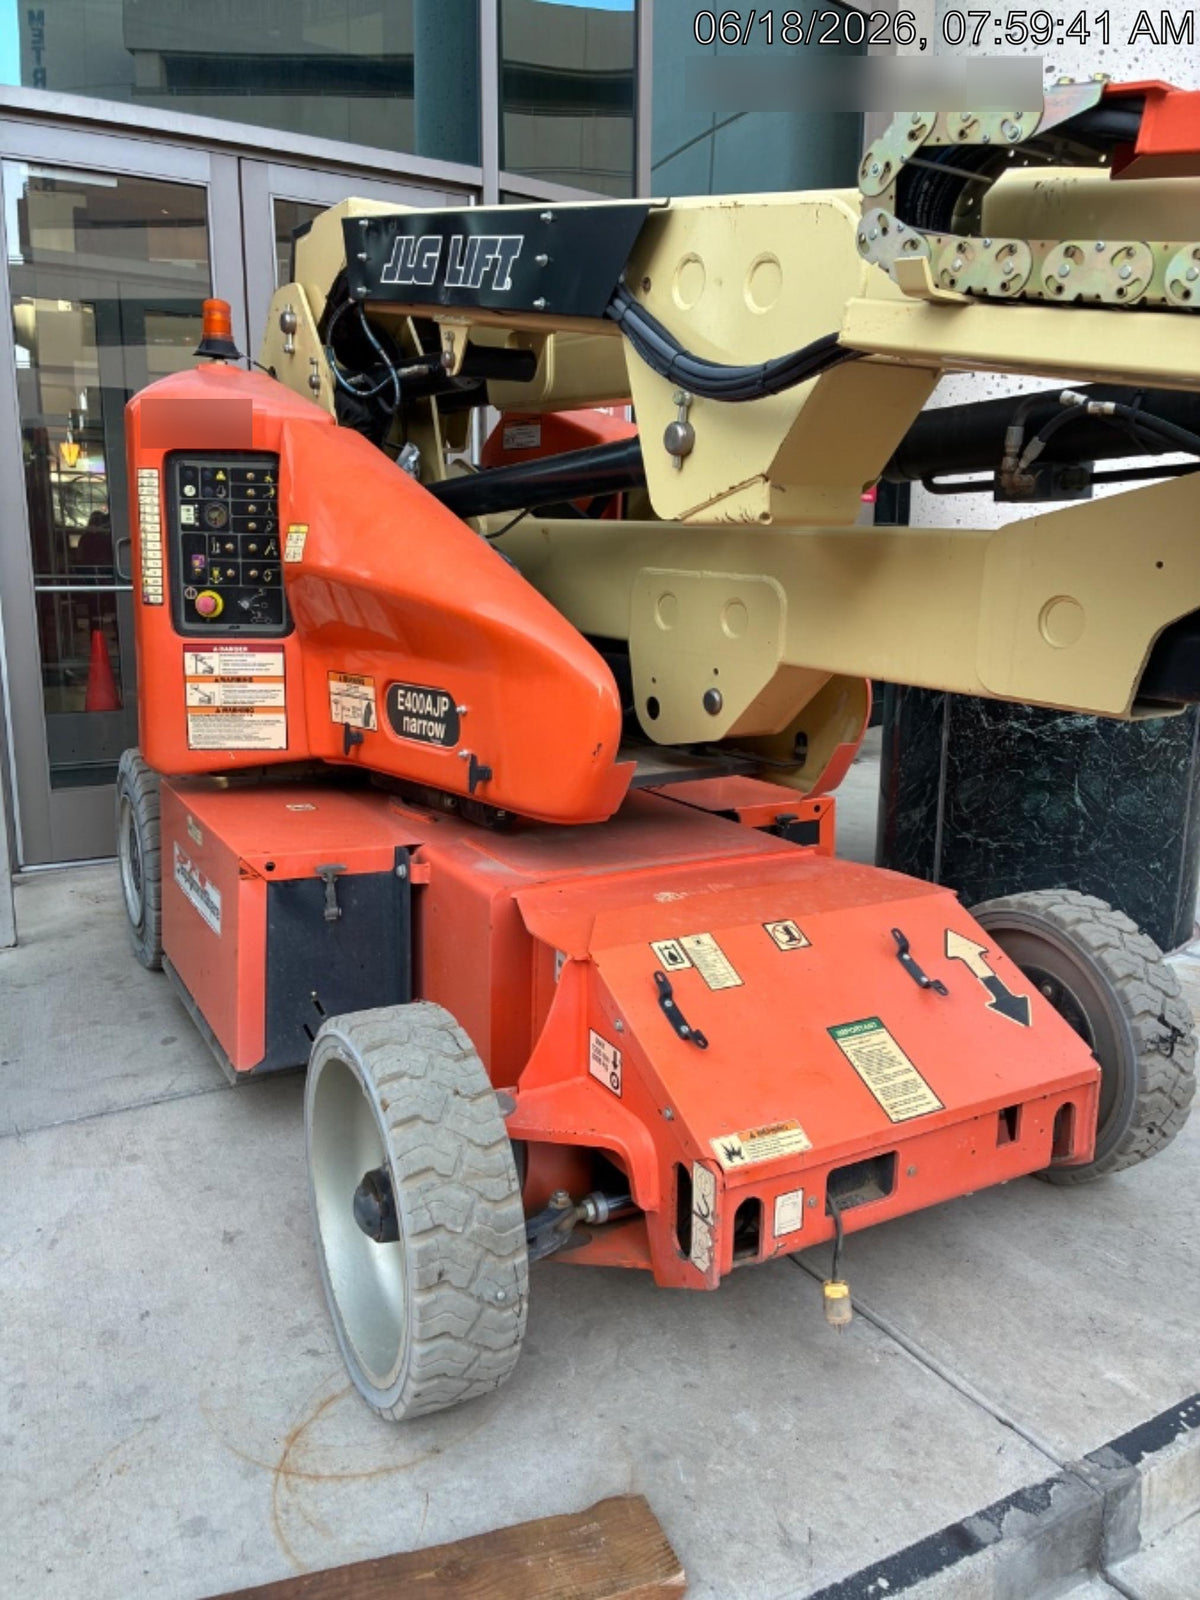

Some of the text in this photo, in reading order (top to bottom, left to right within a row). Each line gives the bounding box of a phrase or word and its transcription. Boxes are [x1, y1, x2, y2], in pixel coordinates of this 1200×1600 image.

[380, 235, 525, 290] JLG LIFT
[397, 689, 450, 718] E400AJP
[402, 716, 446, 739] narrow
